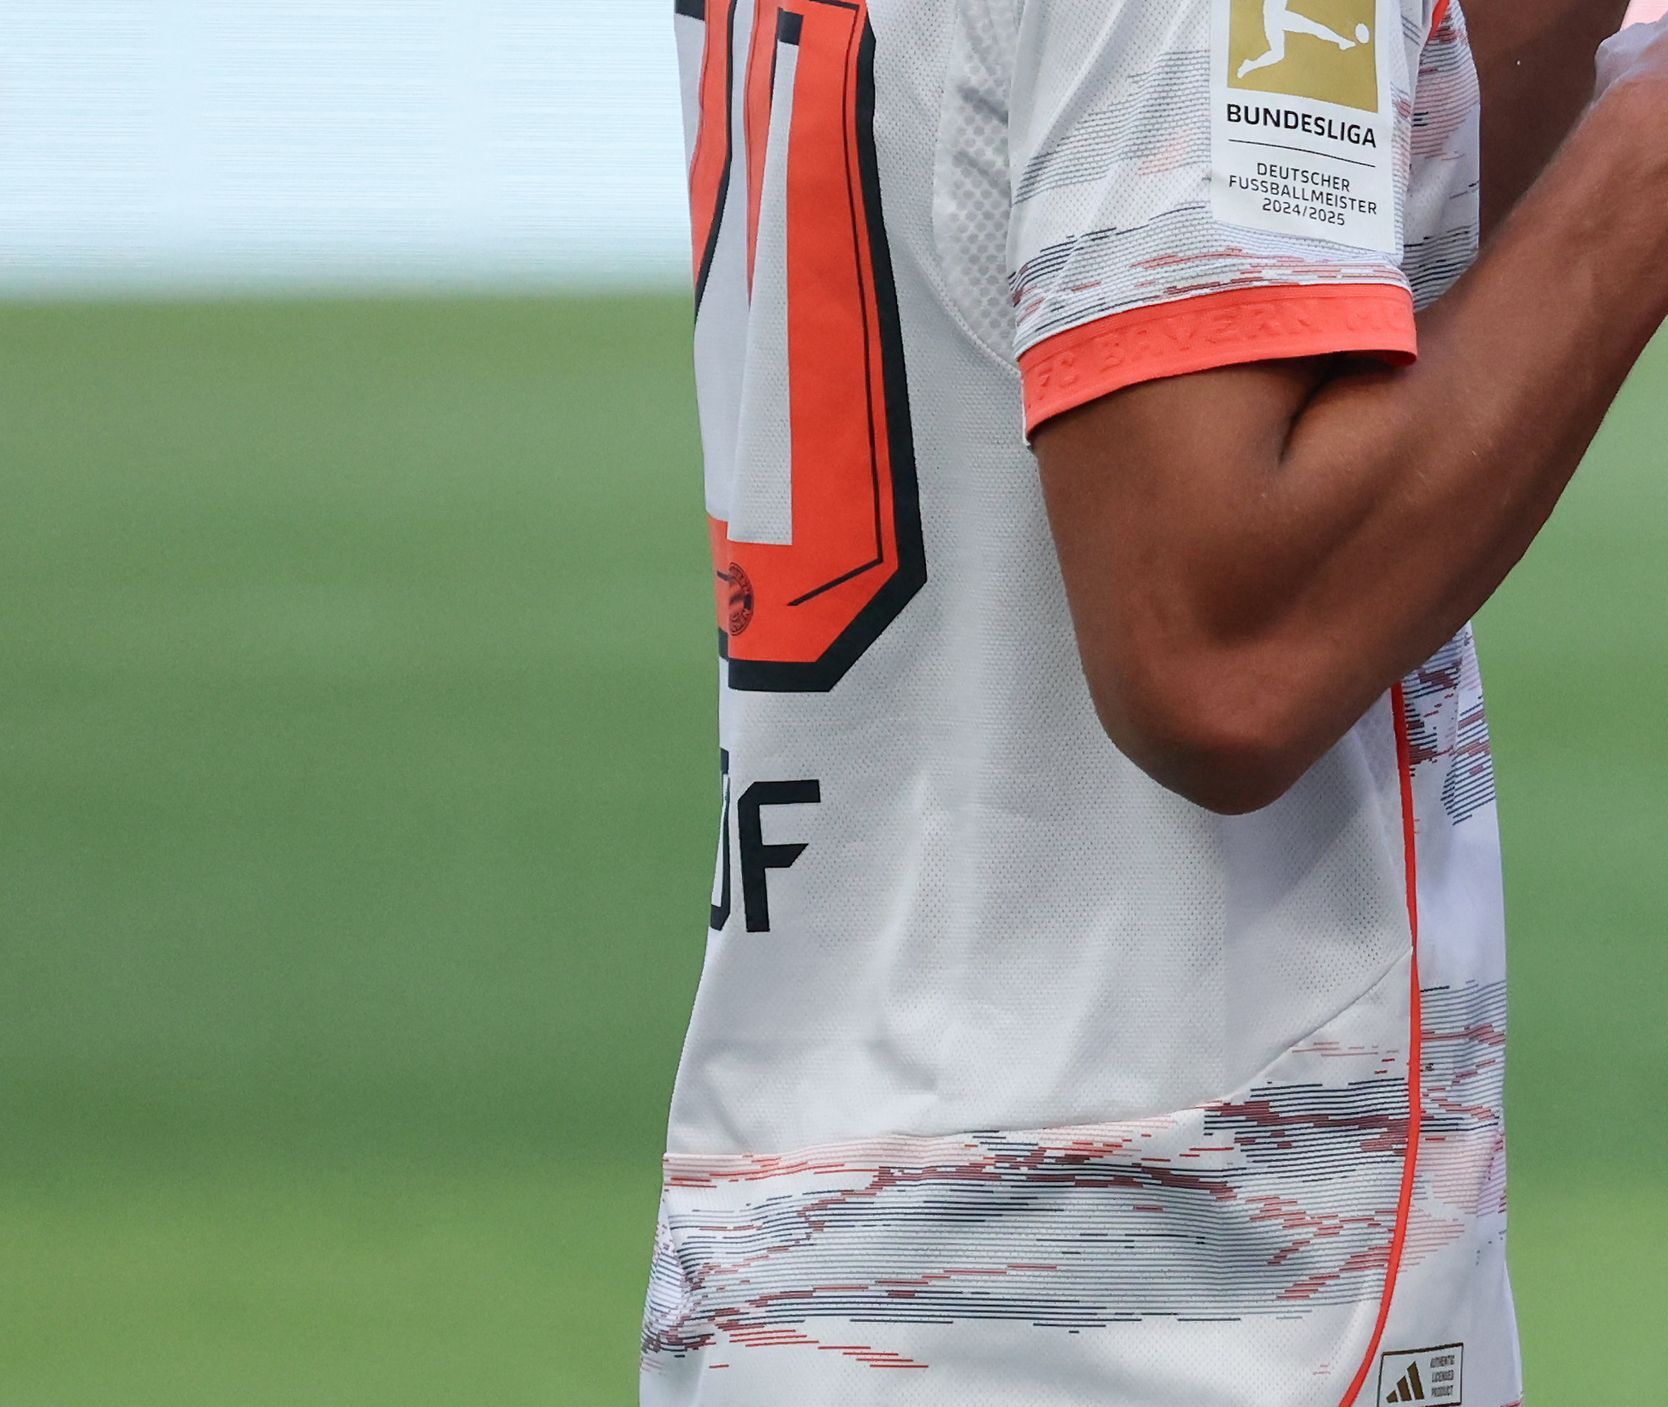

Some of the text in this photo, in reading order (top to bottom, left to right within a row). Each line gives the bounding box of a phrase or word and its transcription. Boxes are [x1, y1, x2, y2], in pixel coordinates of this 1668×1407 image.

[1227, 103, 1376, 148] BUNDESLIGA
[1257, 163, 1350, 192] DEUTSCHER
[1229, 175, 1377, 215] FUSSBALLMEISTER
[1262, 198, 1345, 226] 2024/2025
